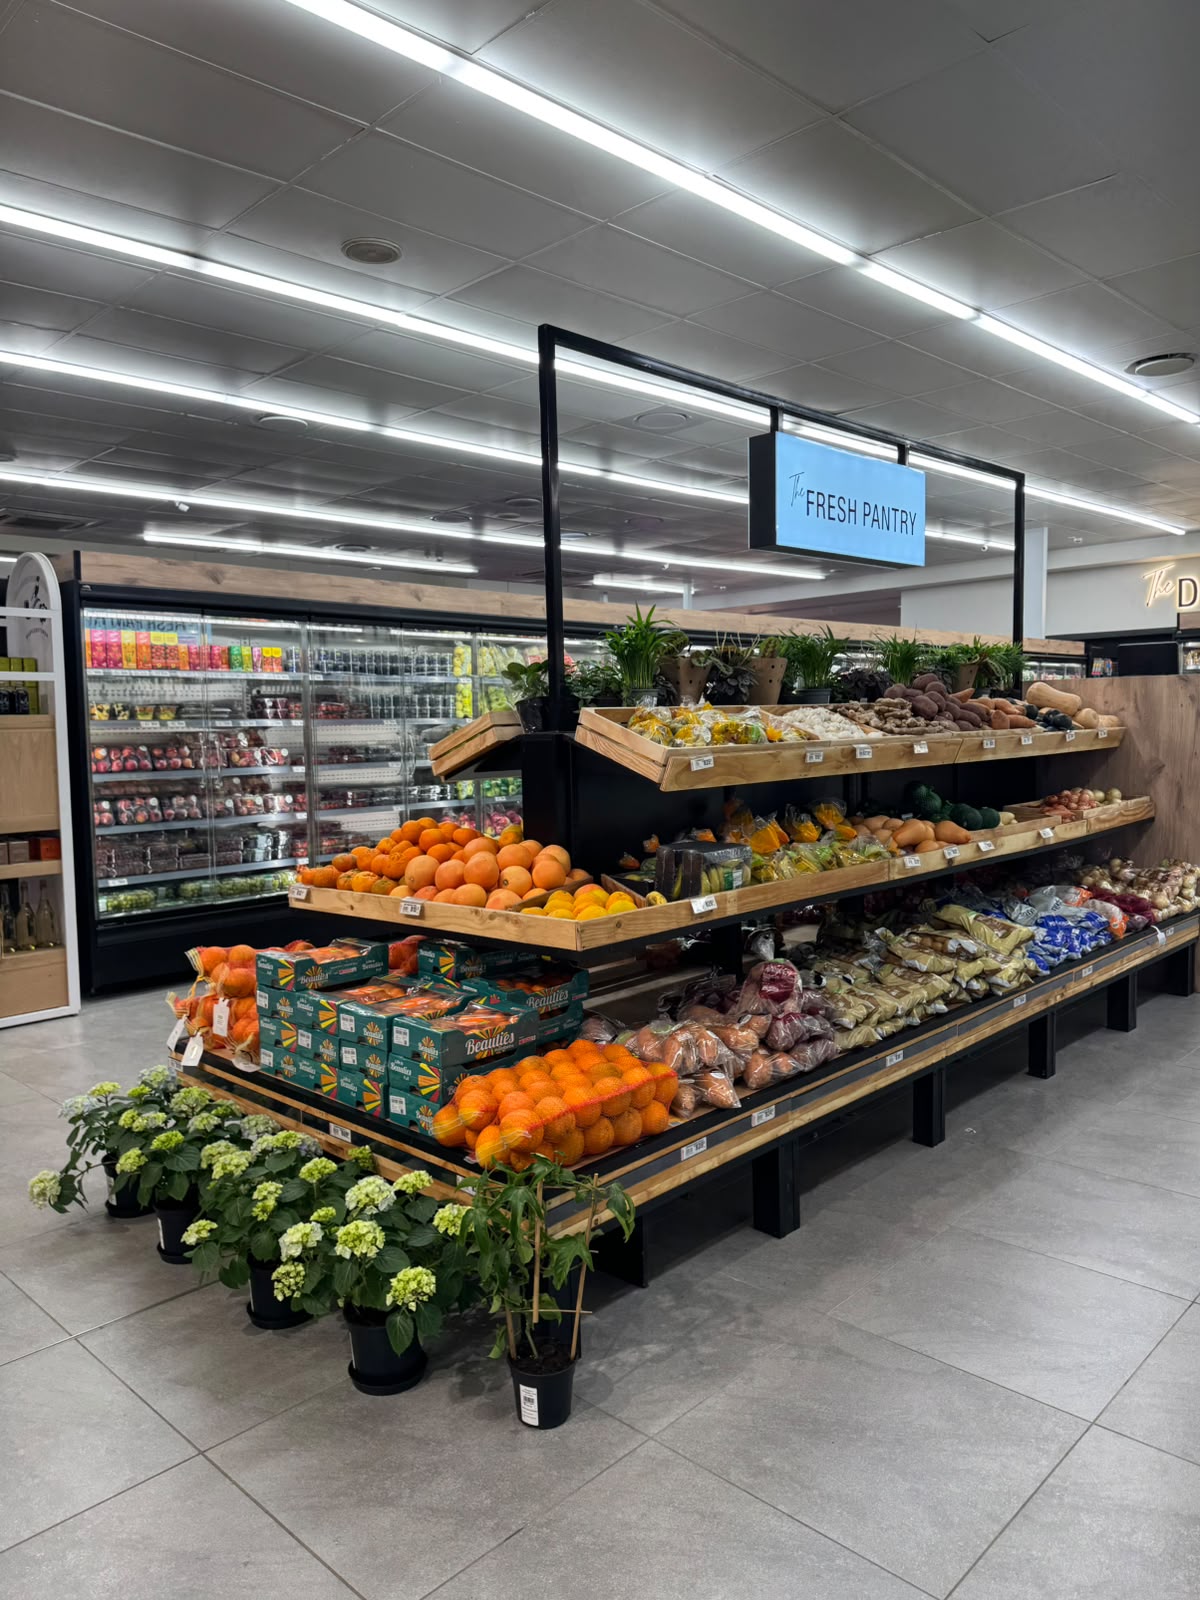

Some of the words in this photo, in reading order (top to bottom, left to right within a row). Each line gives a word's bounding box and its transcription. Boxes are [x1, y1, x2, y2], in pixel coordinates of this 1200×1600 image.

[789, 471, 806, 507] The
[806, 489, 857, 525] FRESH
[862, 501, 917, 536] PANTRY
[1142, 563, 1176, 607] The
[526, 989, 569, 1008] Beauties
[465, 1031, 515, 1056] Beauties
